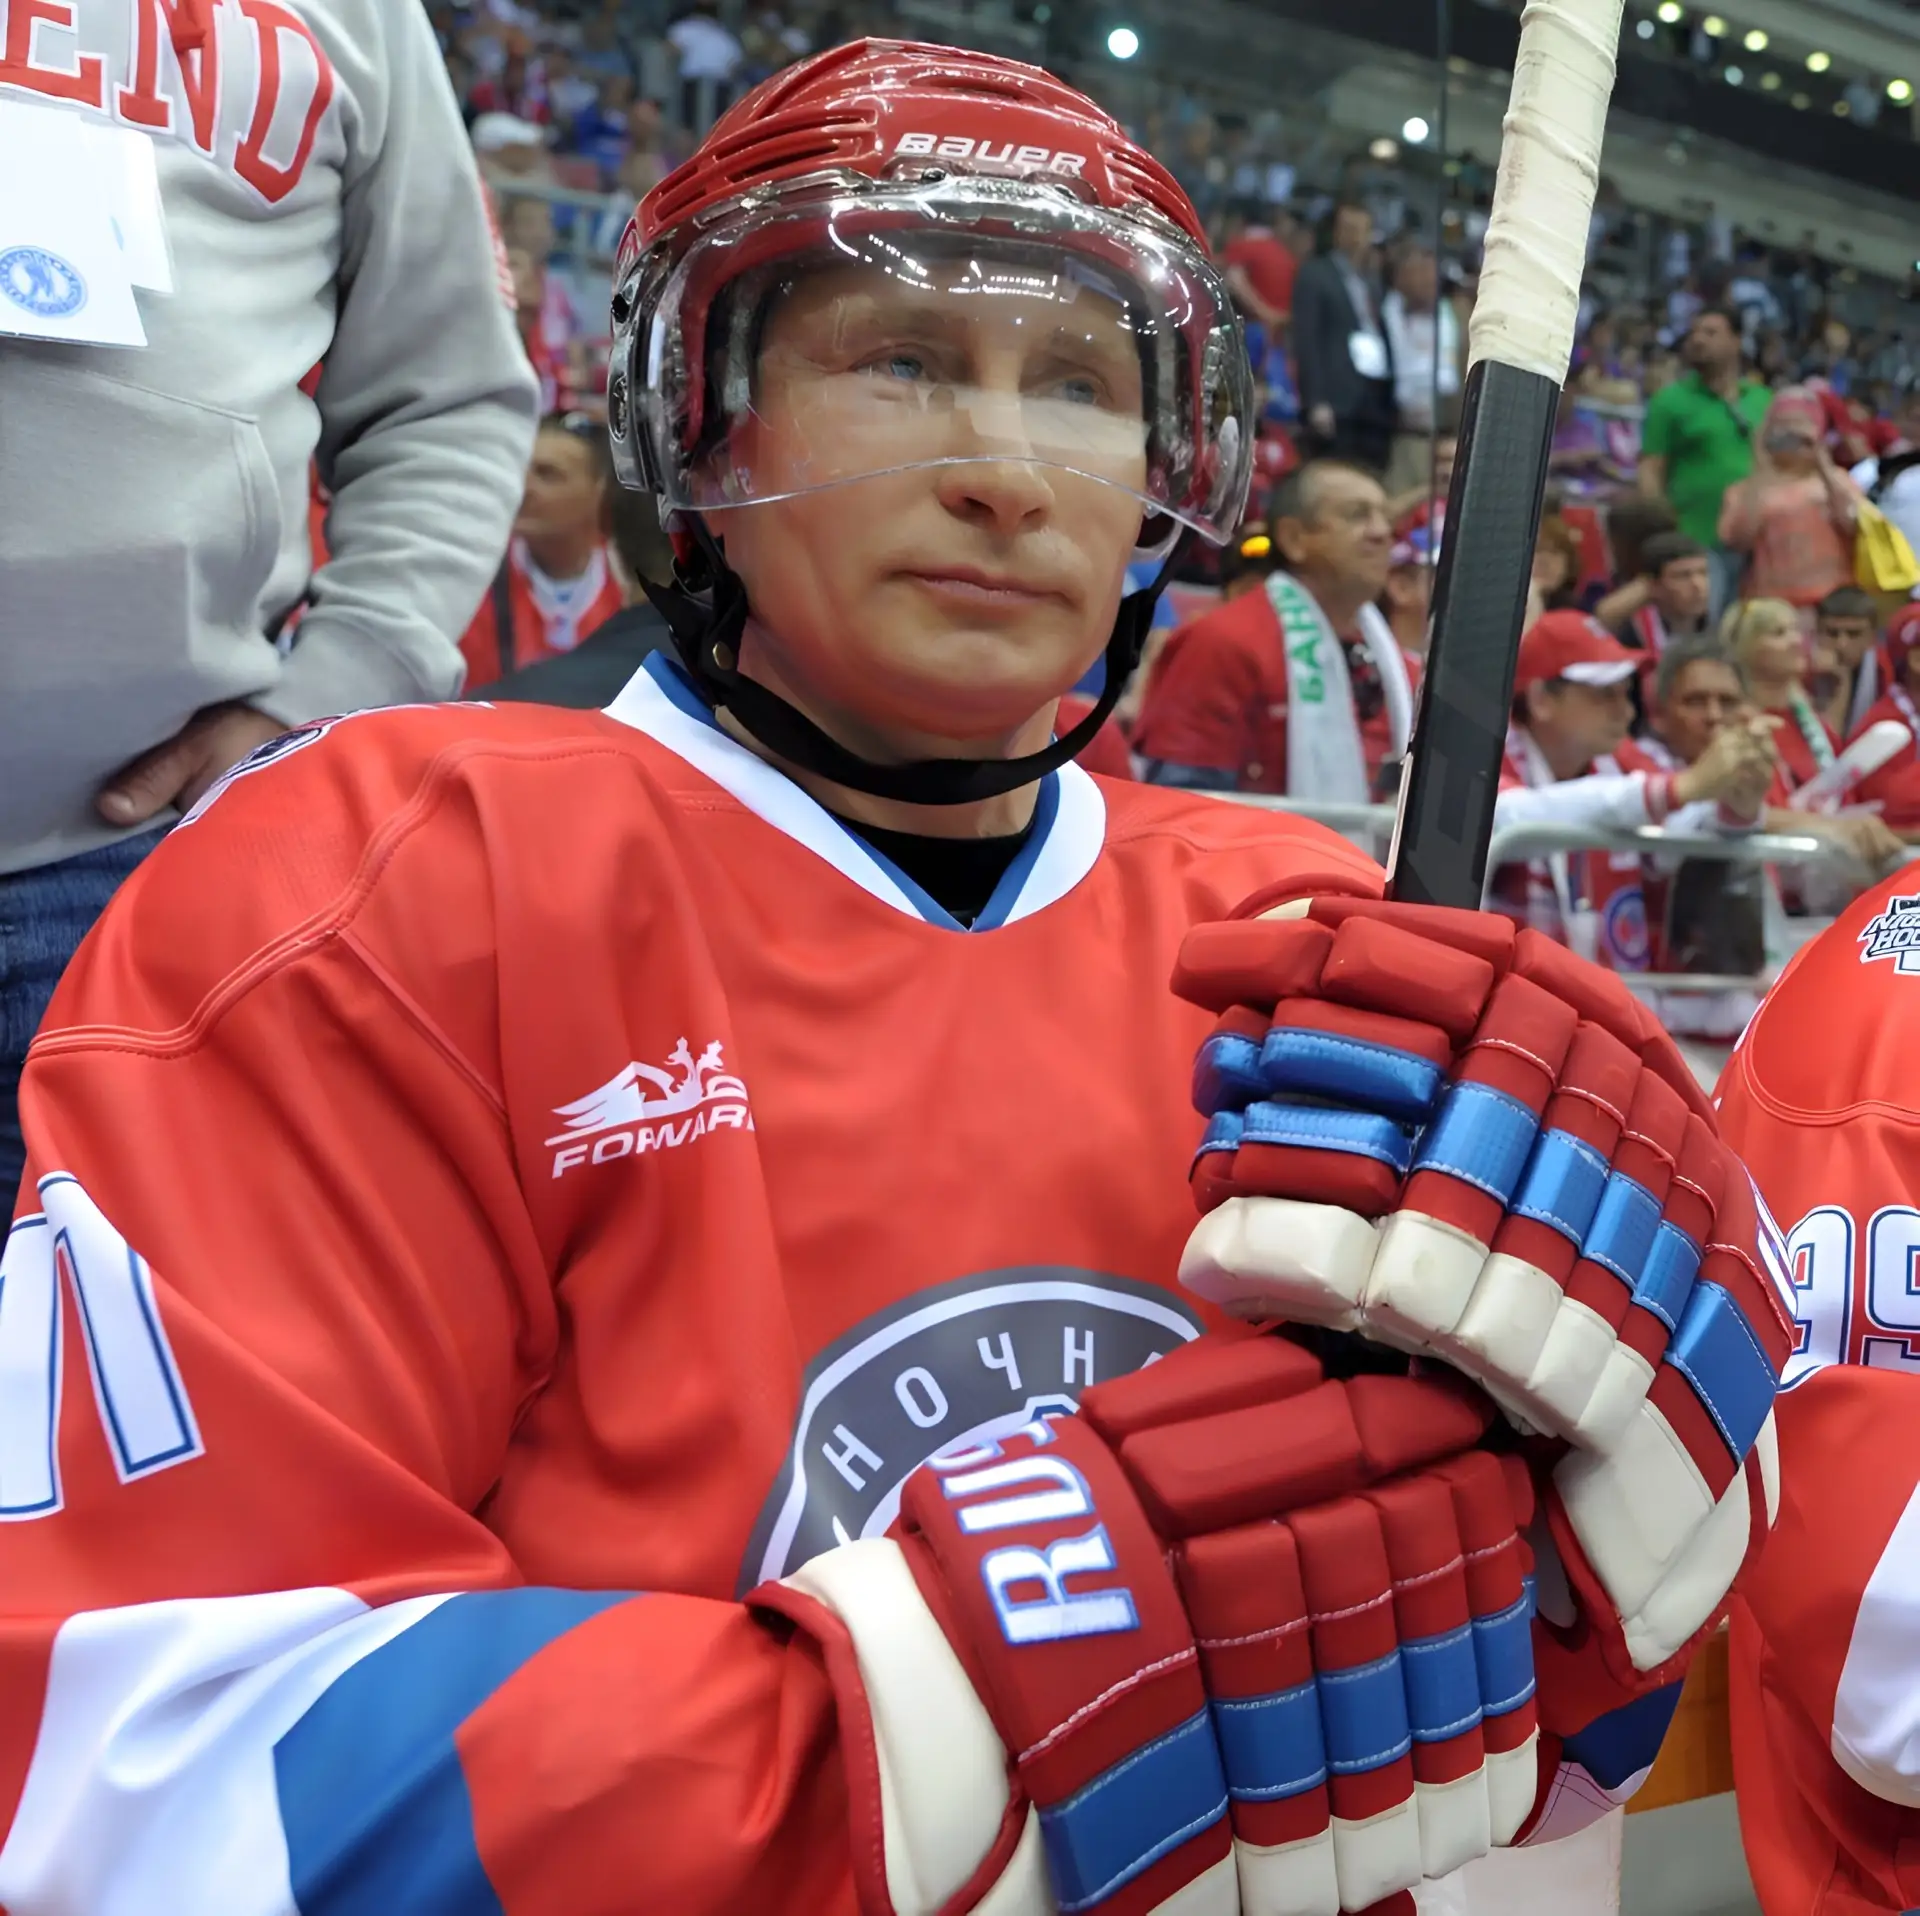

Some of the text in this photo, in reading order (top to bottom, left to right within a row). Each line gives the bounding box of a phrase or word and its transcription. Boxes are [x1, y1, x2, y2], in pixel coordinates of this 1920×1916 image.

[894, 132, 1086, 175] BAUER
[552, 1104, 755, 1179] FORWAR
[821, 1326, 1164, 1492] НОЧН
